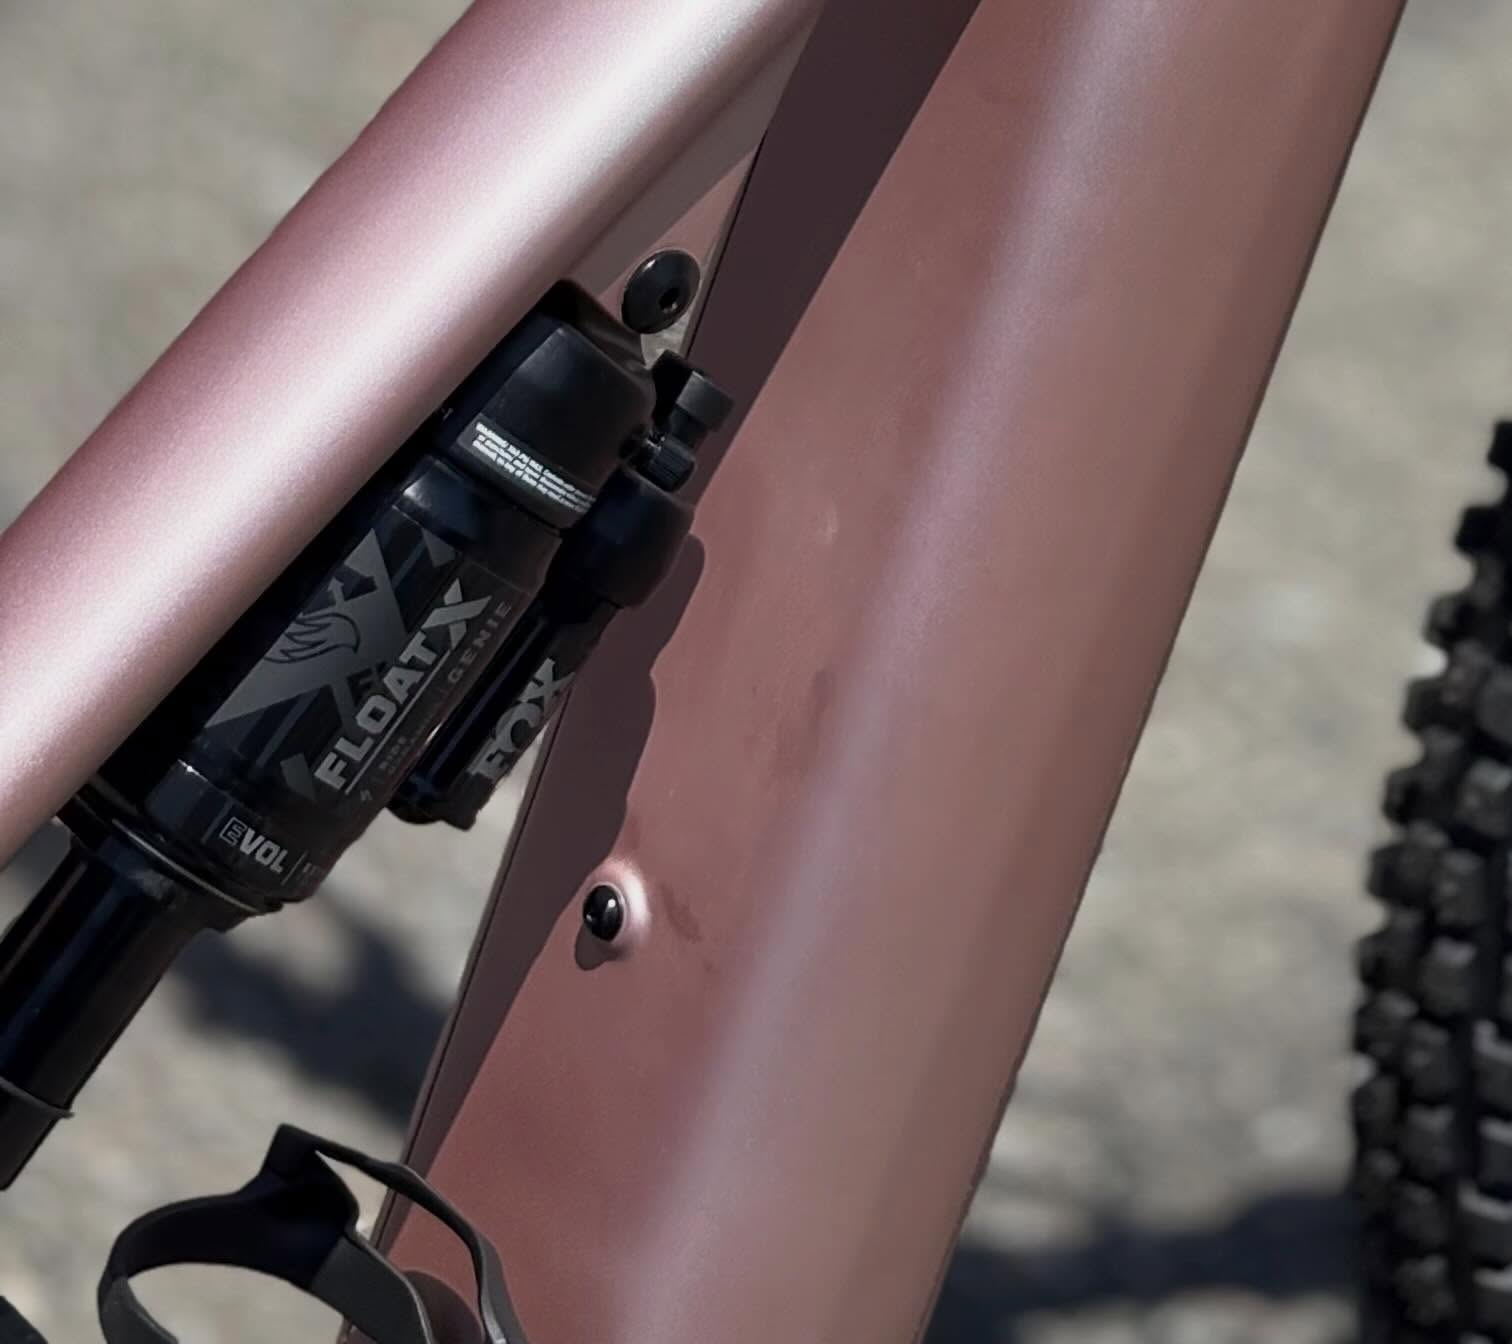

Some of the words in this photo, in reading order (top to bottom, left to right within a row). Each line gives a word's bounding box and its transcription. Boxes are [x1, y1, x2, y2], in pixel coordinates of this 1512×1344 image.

[448, 601, 513, 684] GENIE
[467, 657, 575, 780] FOX
[218, 815, 290, 874] EVOL
